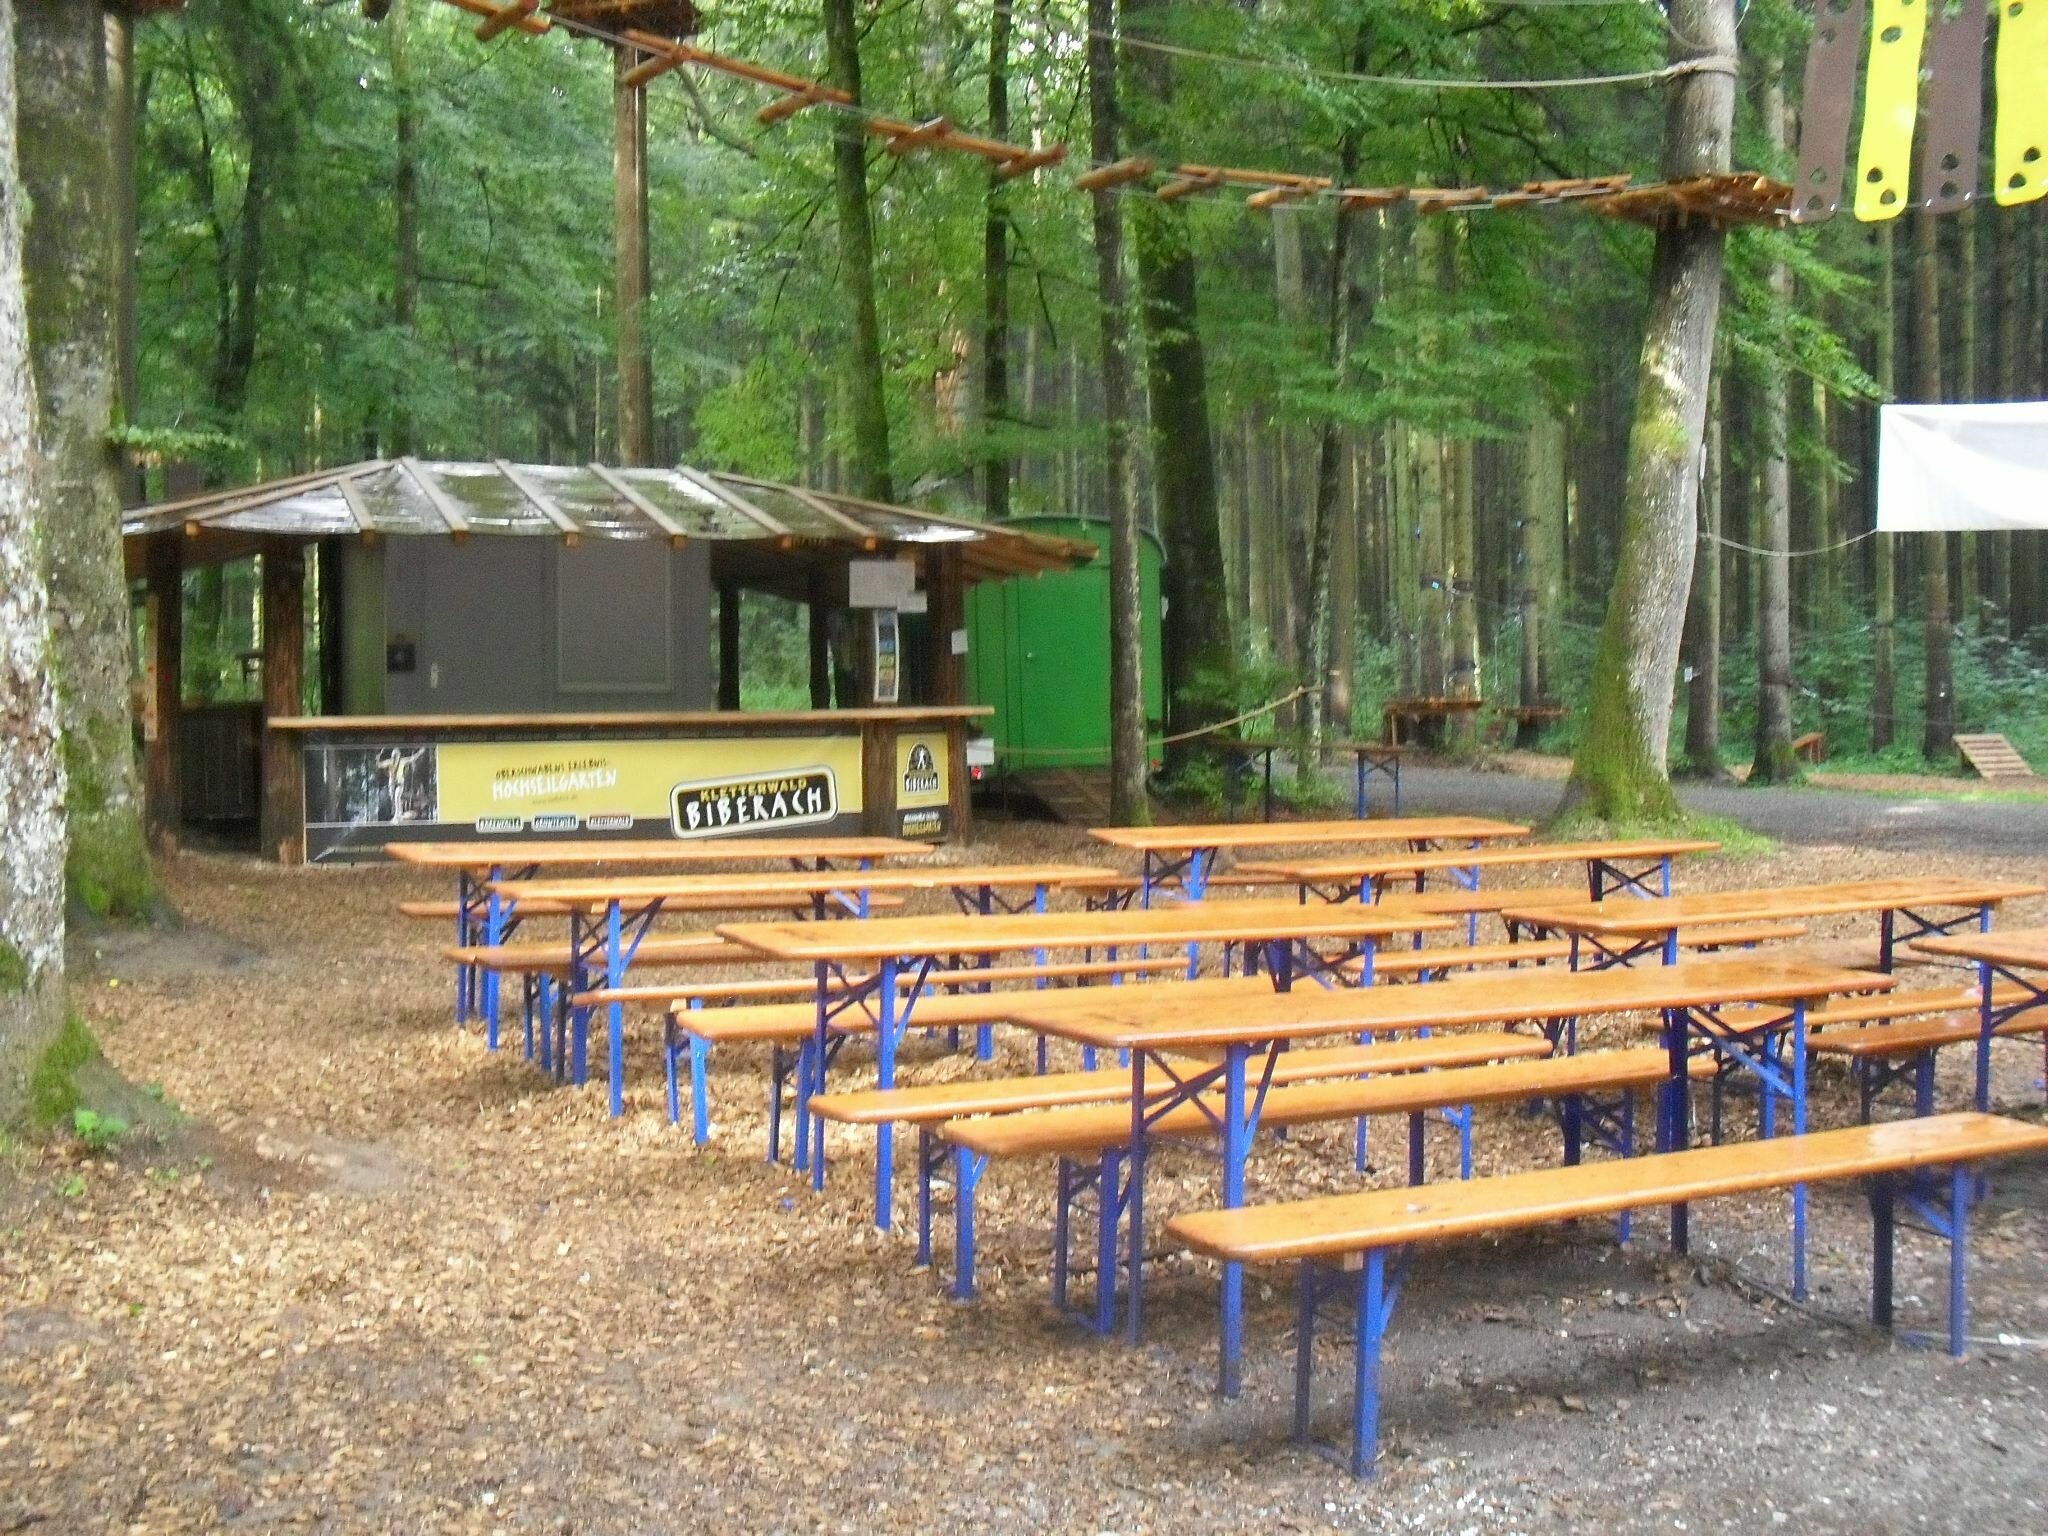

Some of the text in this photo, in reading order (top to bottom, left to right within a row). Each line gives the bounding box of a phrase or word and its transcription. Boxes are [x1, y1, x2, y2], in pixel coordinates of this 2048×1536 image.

[494, 769, 616, 800] HOCHSEILGARTEN
[700, 778, 807, 802] KLETTERWALD
[686, 787, 822, 830] BIBERACH
